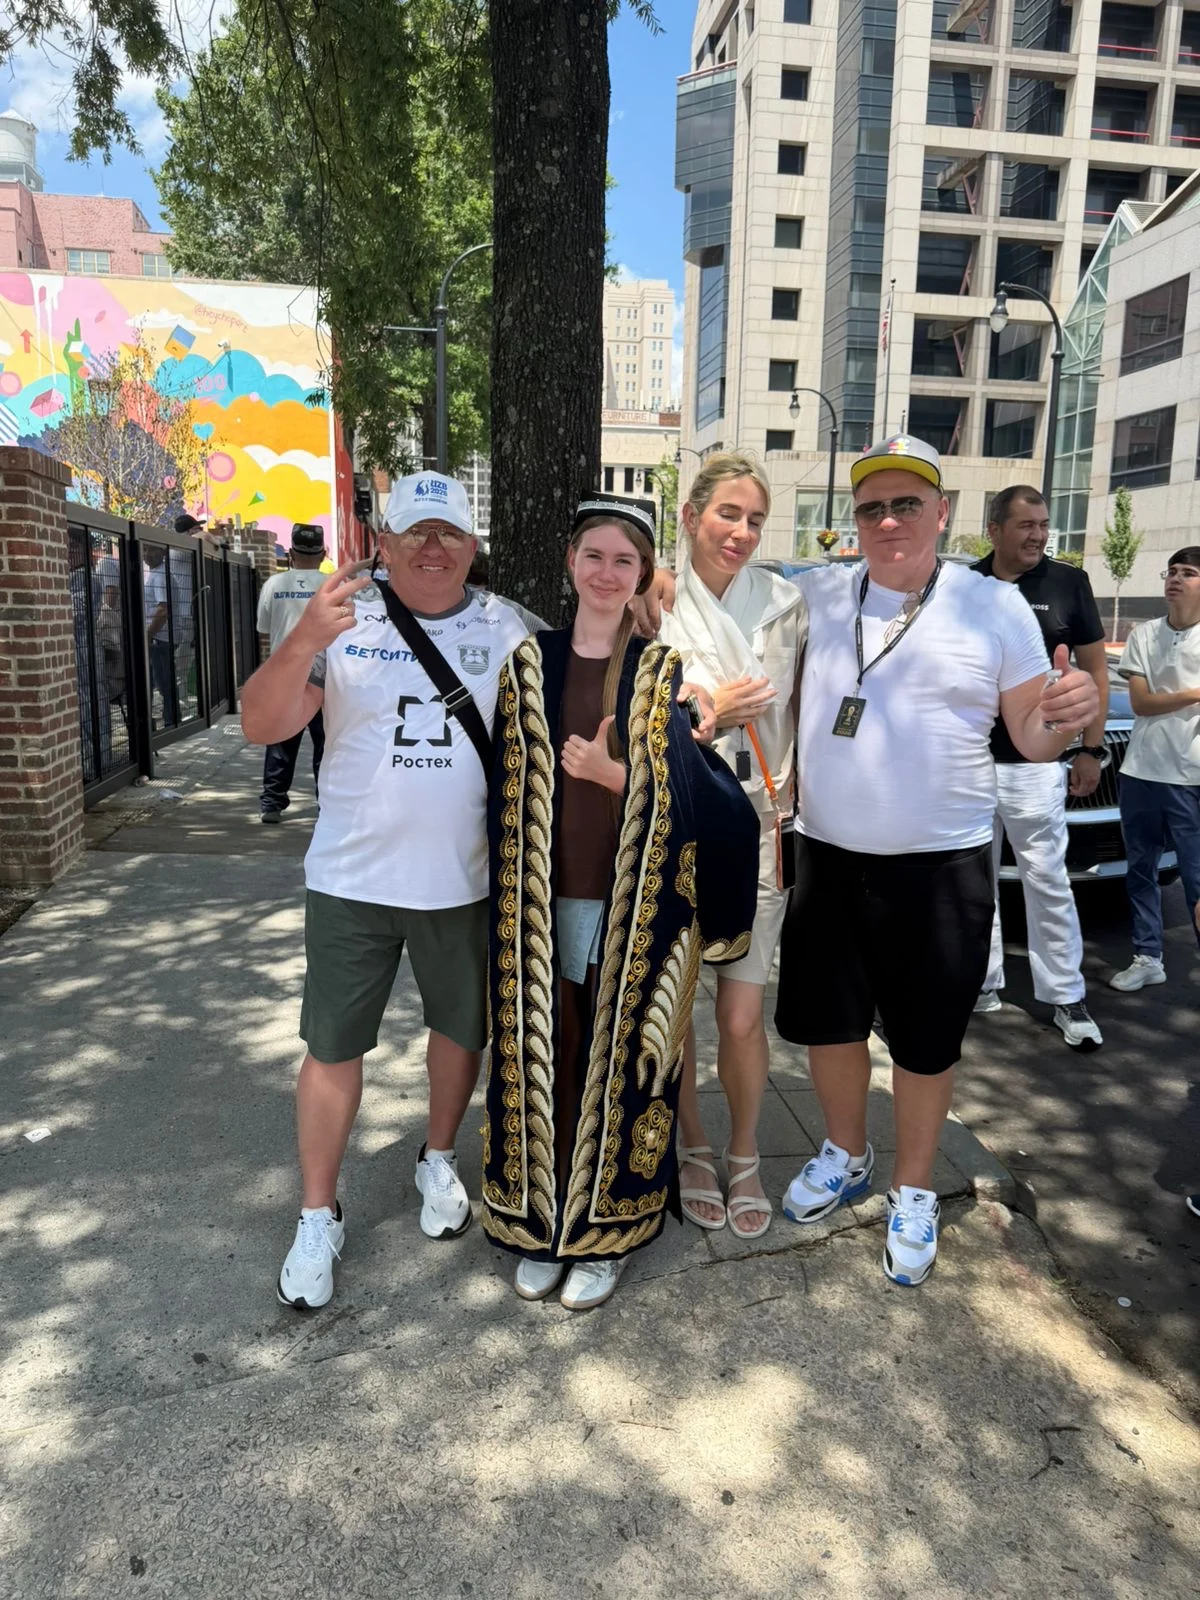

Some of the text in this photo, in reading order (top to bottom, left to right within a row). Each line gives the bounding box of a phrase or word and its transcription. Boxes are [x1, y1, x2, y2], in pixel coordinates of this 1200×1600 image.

[603, 411, 647, 421] FURNITURE
[430, 480, 448, 491] UZB
[392, 754, 453, 768] Ростех
